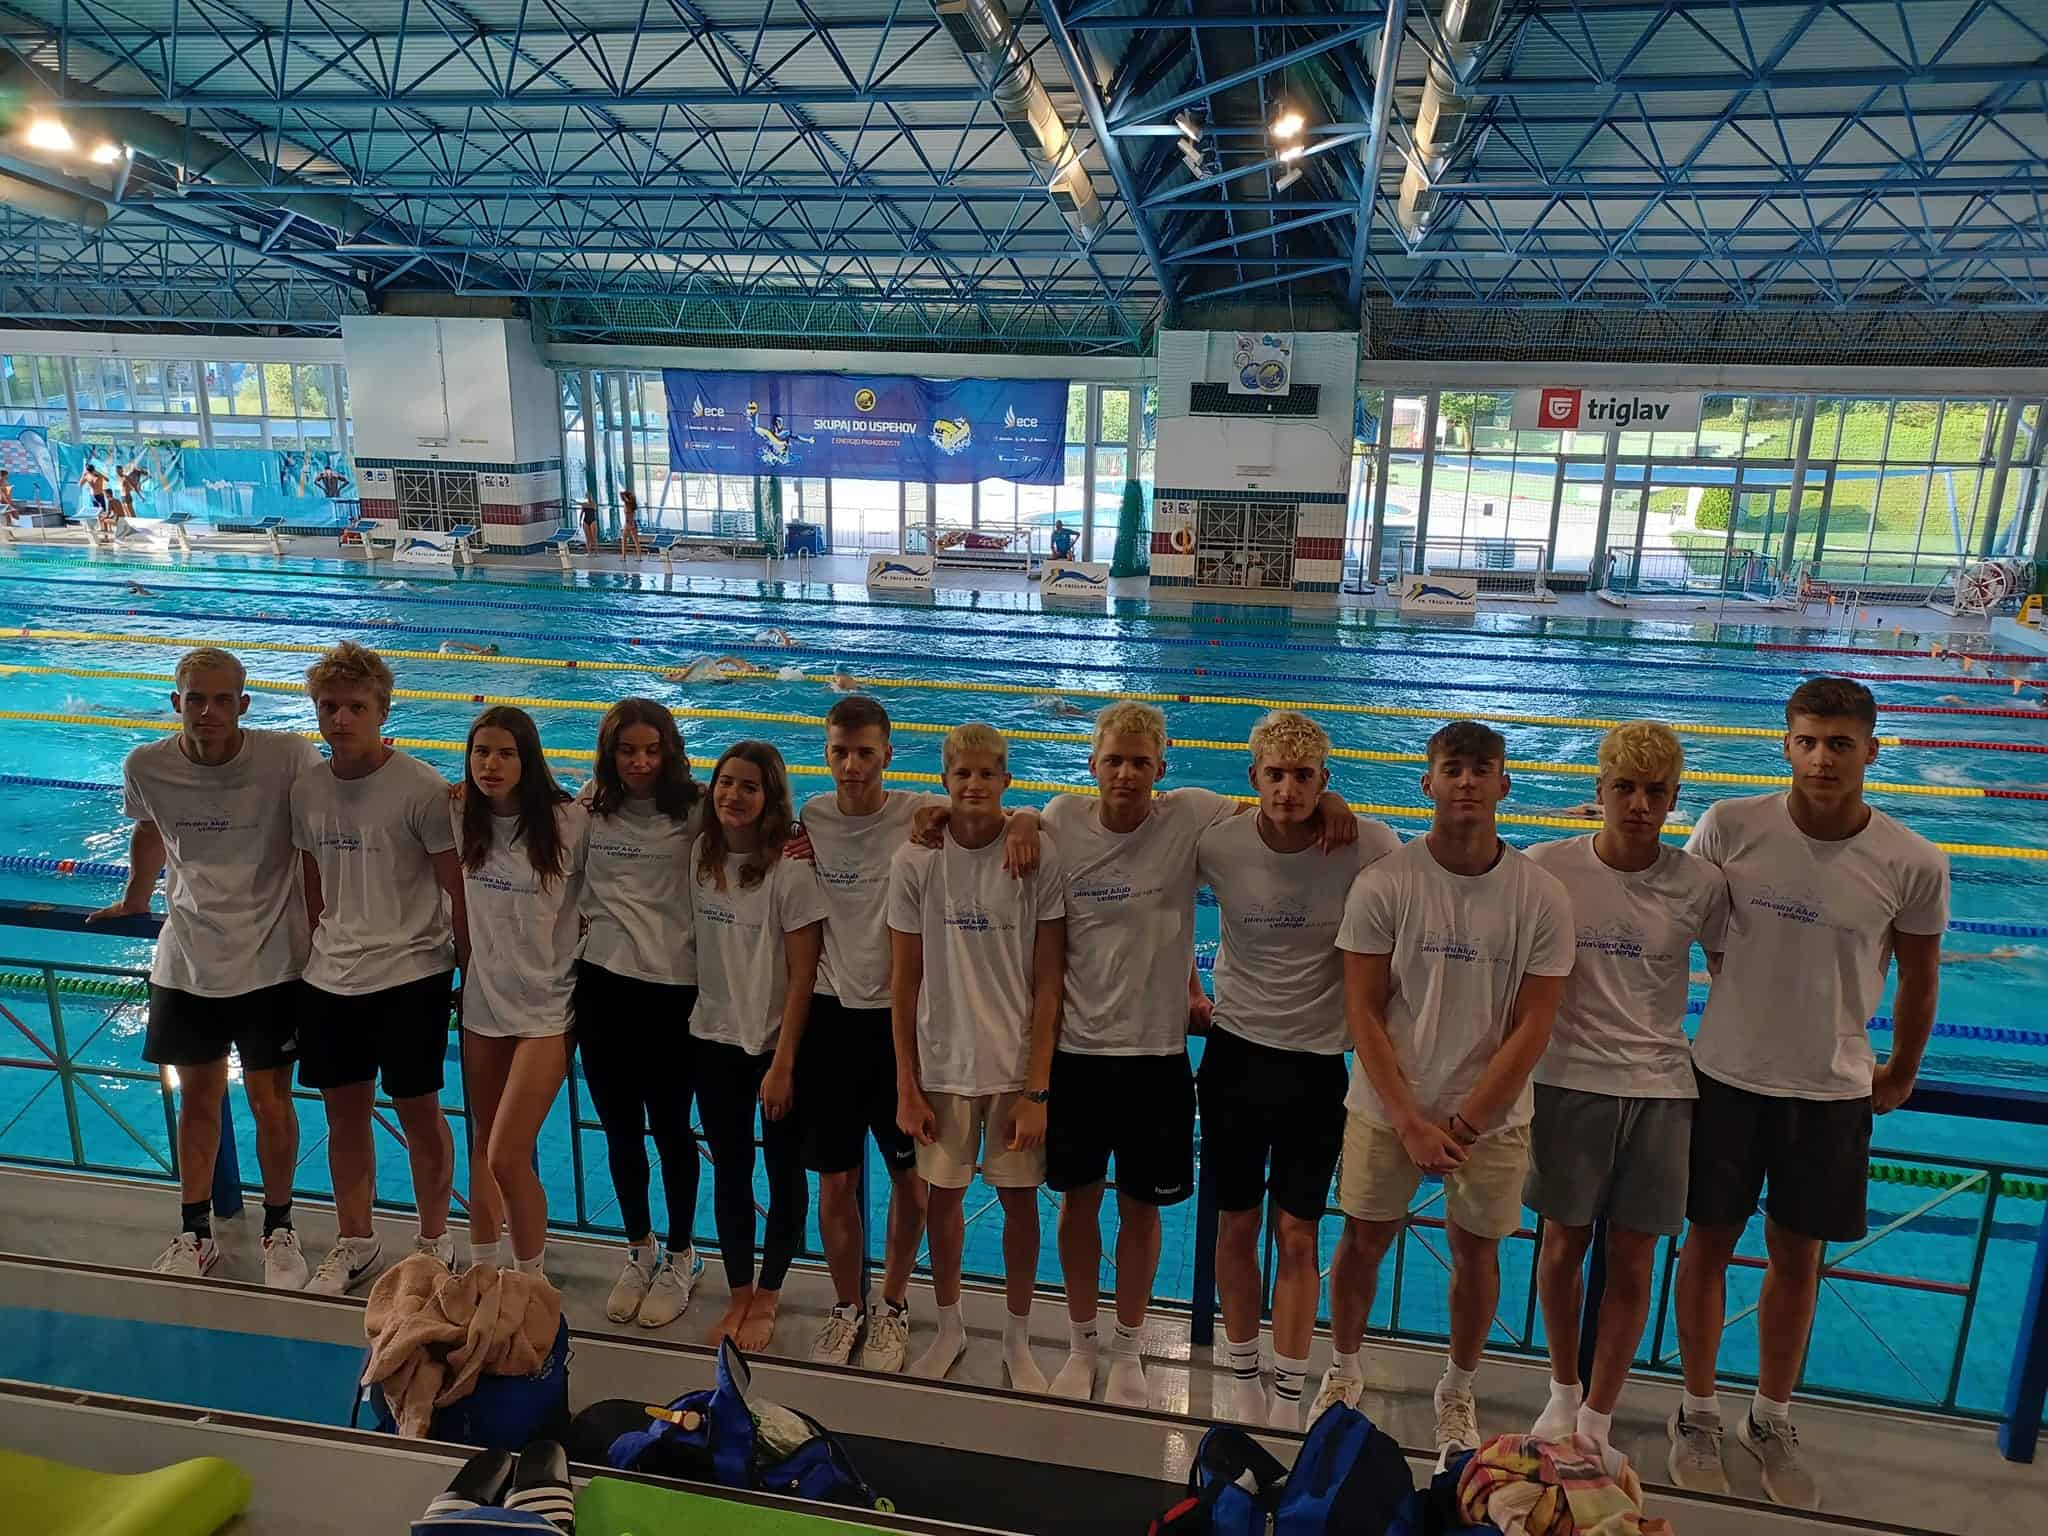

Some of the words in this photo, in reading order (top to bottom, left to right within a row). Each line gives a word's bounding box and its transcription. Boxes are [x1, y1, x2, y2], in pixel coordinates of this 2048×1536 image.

[704, 407, 725, 417] ece
[1587, 397, 1670, 427] triglav
[814, 419, 851, 432] SKUPAJ
[852, 421, 868, 431] DO
[869, 421, 917, 433] USPEHOV
[1016, 417, 1038, 428] ece
[1749, 896, 1793, 913] plavalni
[1794, 903, 1819, 919] klub
[1576, 940, 1618, 951] plavalni
[1619, 942, 1643, 952] klub
